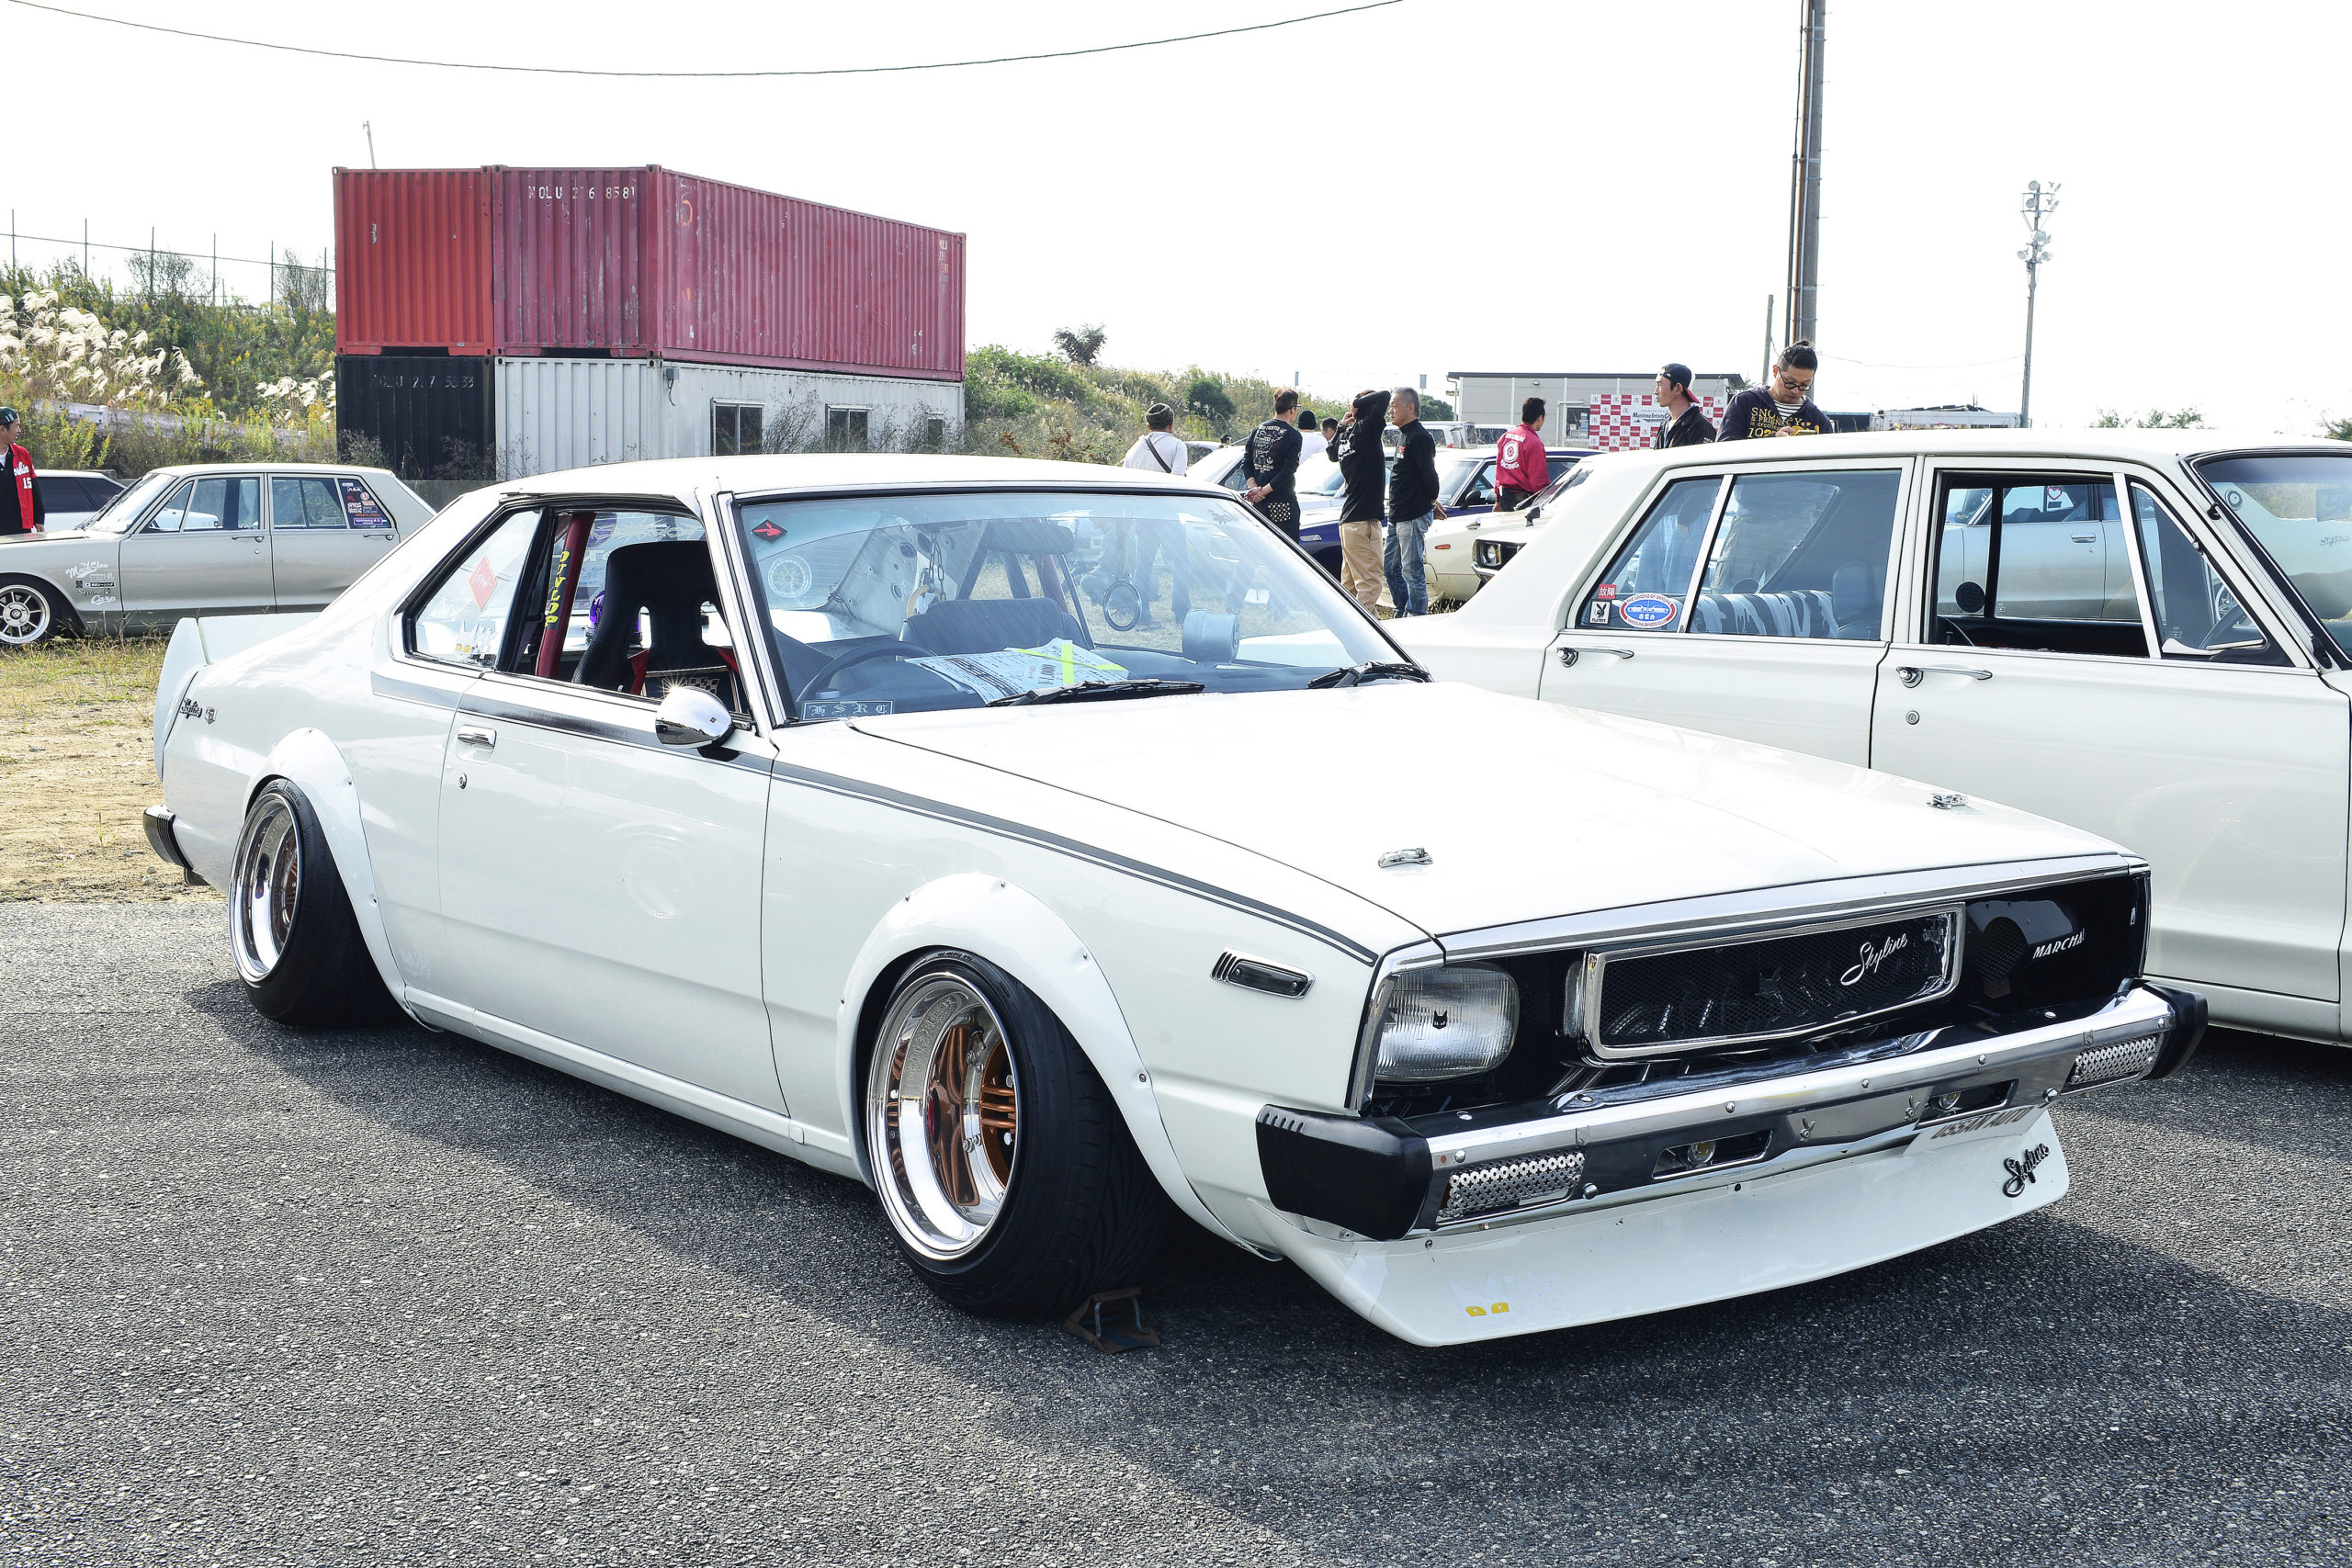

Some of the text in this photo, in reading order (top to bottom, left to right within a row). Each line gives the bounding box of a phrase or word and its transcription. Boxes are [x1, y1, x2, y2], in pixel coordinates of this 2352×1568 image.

[571, 186, 595, 199] 26
[605, 186, 636, 199] 8581
[23, 477, 32, 490] 15
[544, 550, 571, 628] DUNLOP
[1599, 587, 1615, 597] 故障
[91, 594, 117, 605] Carp
[1840, 932, 1908, 987] Skyline
[1983, 1105, 2036, 1129] AUTO
[2003, 1143, 2051, 1199] Skyline
